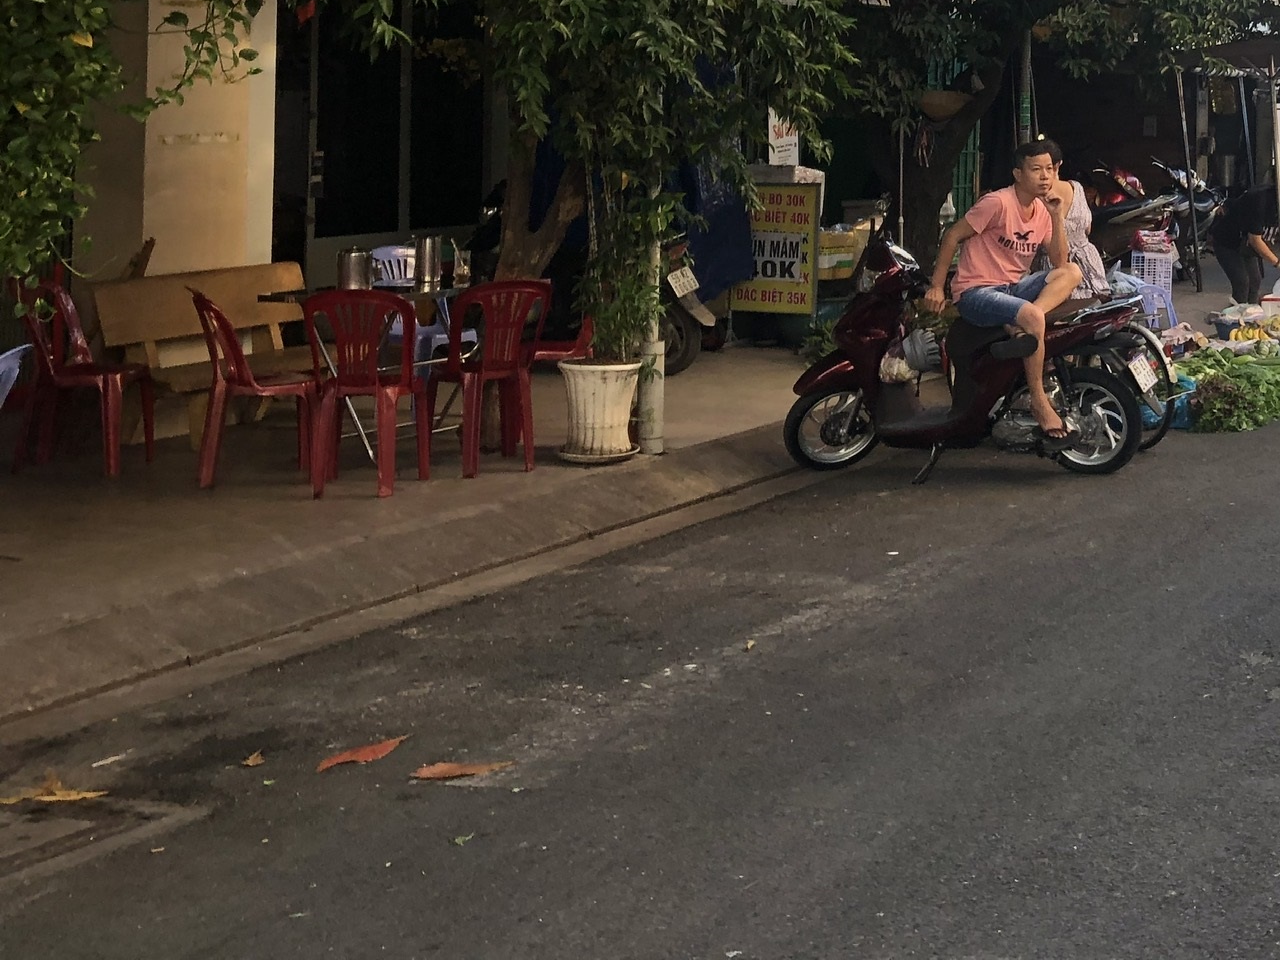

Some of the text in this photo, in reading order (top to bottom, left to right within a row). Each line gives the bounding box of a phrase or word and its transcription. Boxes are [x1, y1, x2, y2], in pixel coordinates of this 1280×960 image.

[786, 194, 805, 207] 30K
[790, 212, 810, 225] 40K
[997, 235, 1040, 253] HOLLISTE
[787, 291, 806, 305] 35K
